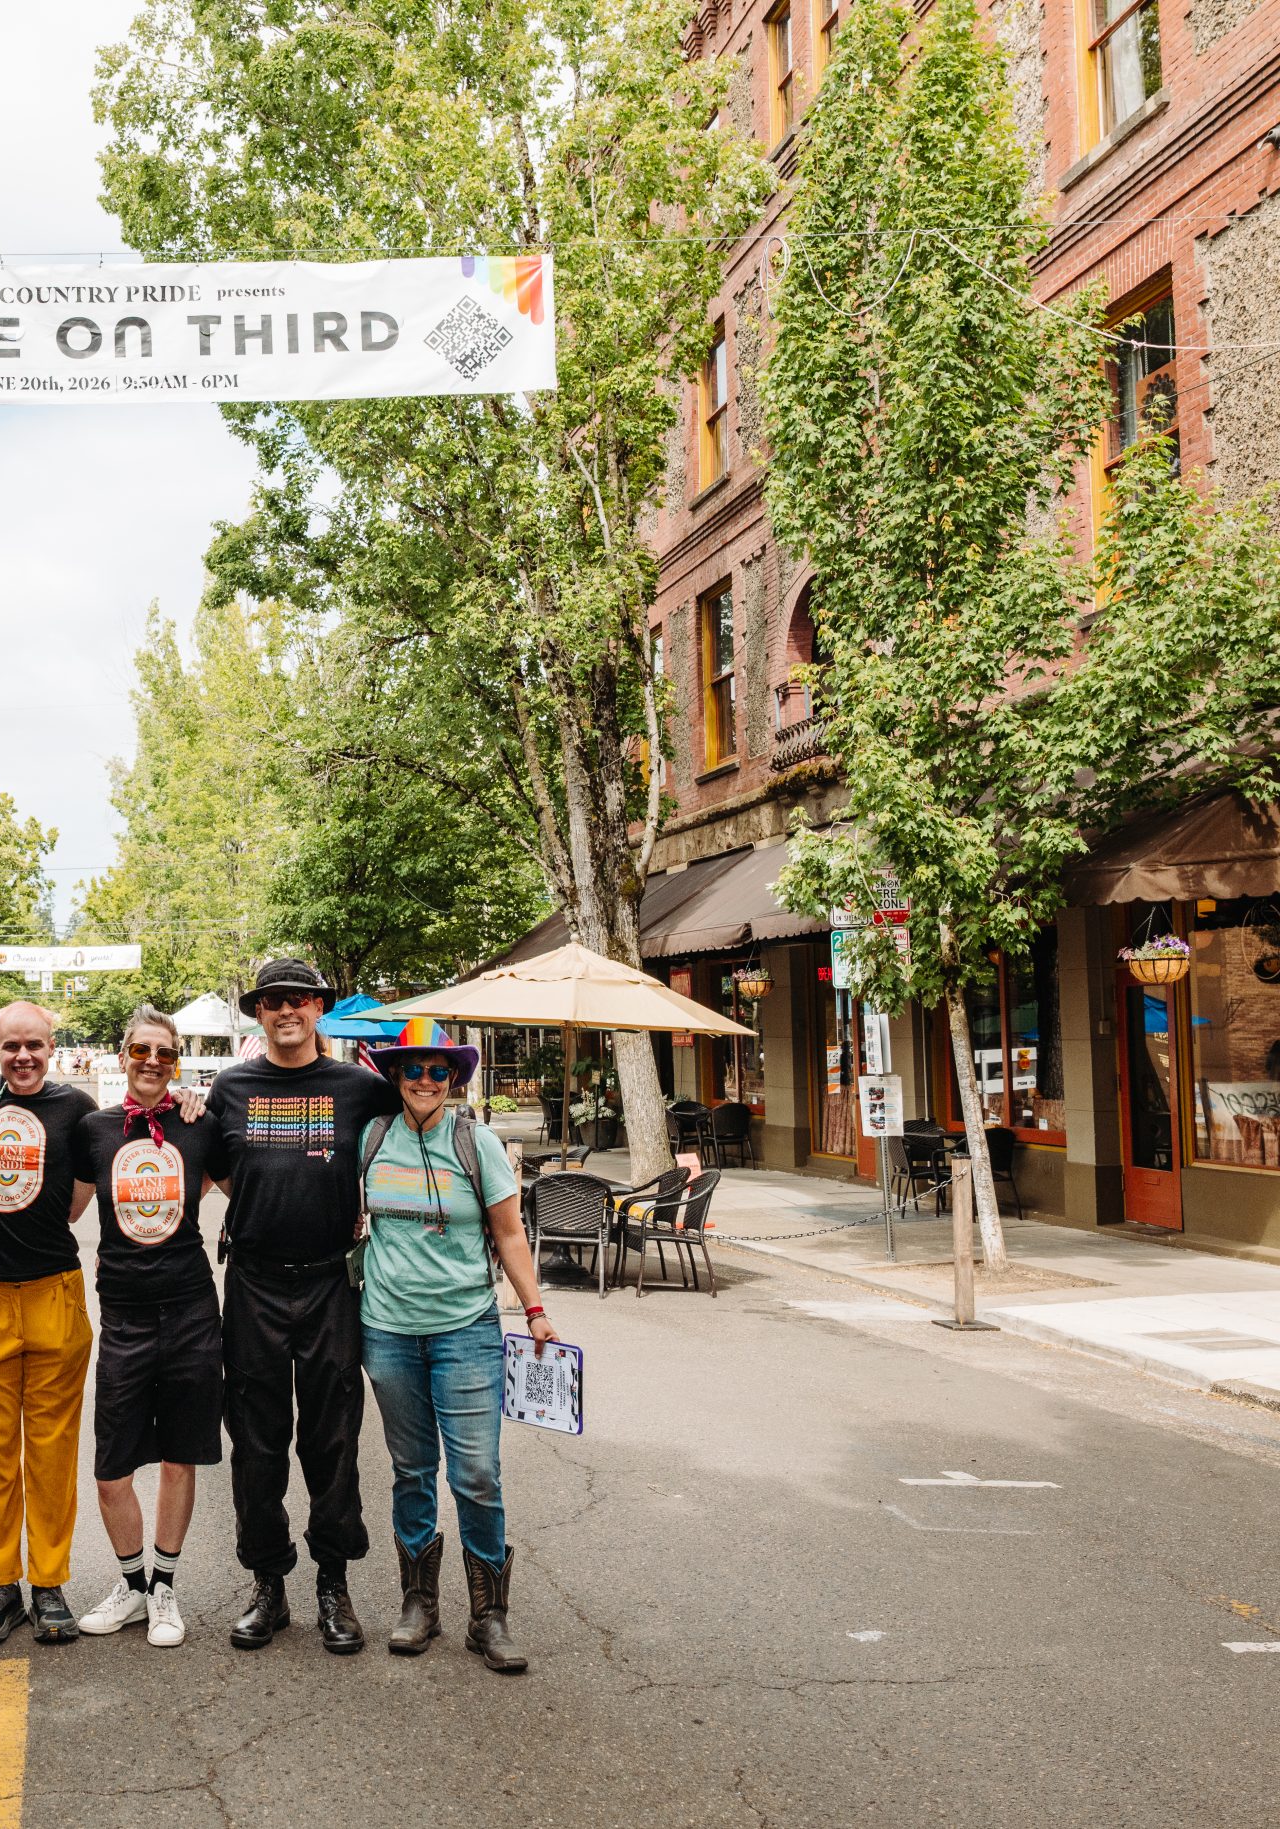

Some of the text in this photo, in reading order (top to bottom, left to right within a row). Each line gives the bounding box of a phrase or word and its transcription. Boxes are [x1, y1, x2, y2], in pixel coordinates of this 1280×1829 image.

[126, 284, 201, 302] PRIDE
[217, 286, 286, 300] presents
[187, 311, 400, 356] THIRD
[20, 376, 64, 393] 20th,
[68, 376, 111, 391] 2026
[201, 374, 239, 389] 6PM
[834, 935, 842, 950] 2
[309, 1096, 333, 1104] pride
[309, 1115, 334, 1123] pride
[7, 1116, 36, 1139] TOGETHER
[246, 1128, 268, 1136] wine
[309, 1128, 334, 1136] pride
[309, 1122, 334, 1130] pride
[309, 1135, 334, 1143] pride
[122, 1149, 174, 1172] BETTER TOGETHER
[21, 1177, 34, 1195] HERE
[128, 1177, 166, 1187] WINE
[130, 1192, 166, 1201] PRIDE
[125, 1208, 175, 1234] YOU BELONG HERE
[387, 1213, 422, 1223] country
